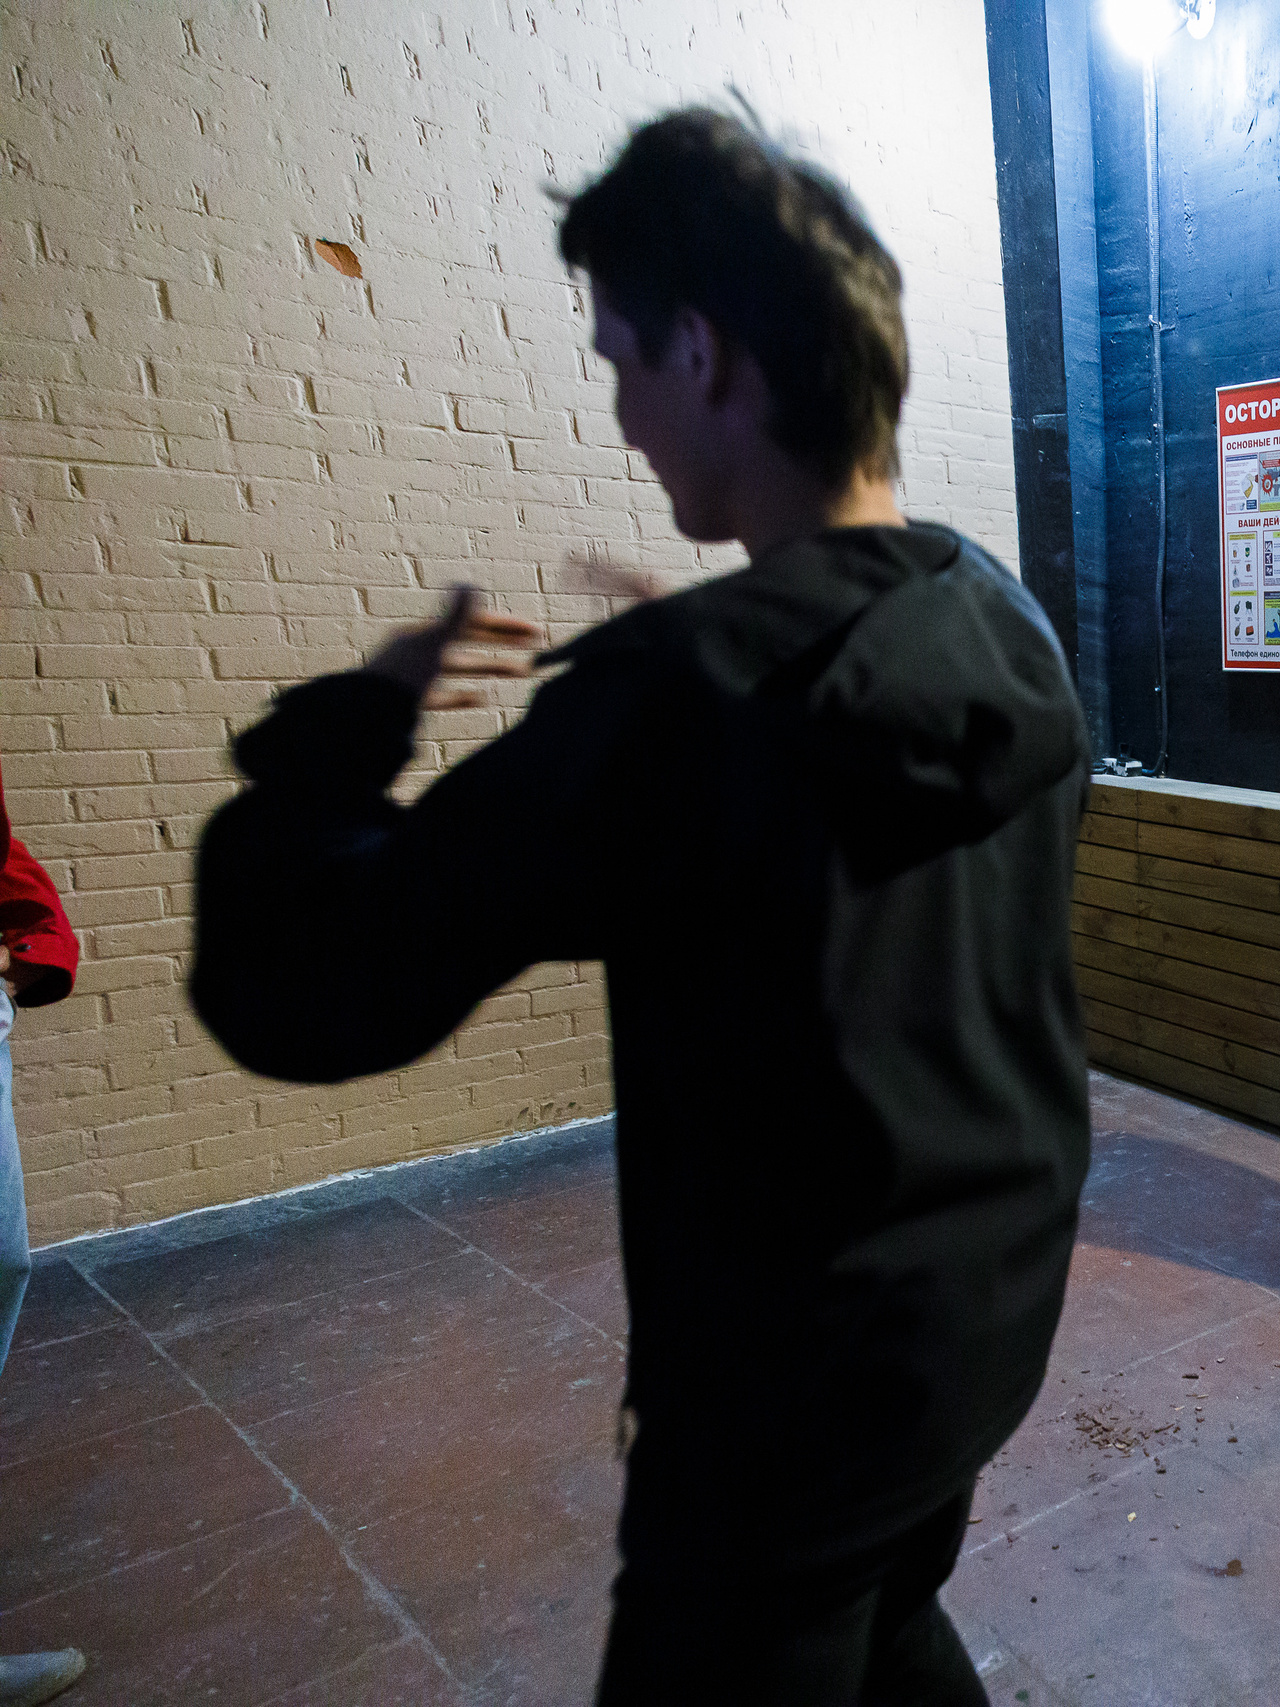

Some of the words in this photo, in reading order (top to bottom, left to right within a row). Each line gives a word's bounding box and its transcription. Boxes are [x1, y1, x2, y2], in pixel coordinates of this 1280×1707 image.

[1226, 437, 1271, 450] ОСНОВНЫЕ
[1238, 518, 1261, 528] ВАШИ
[1231, 649, 1259, 659] Телефон
